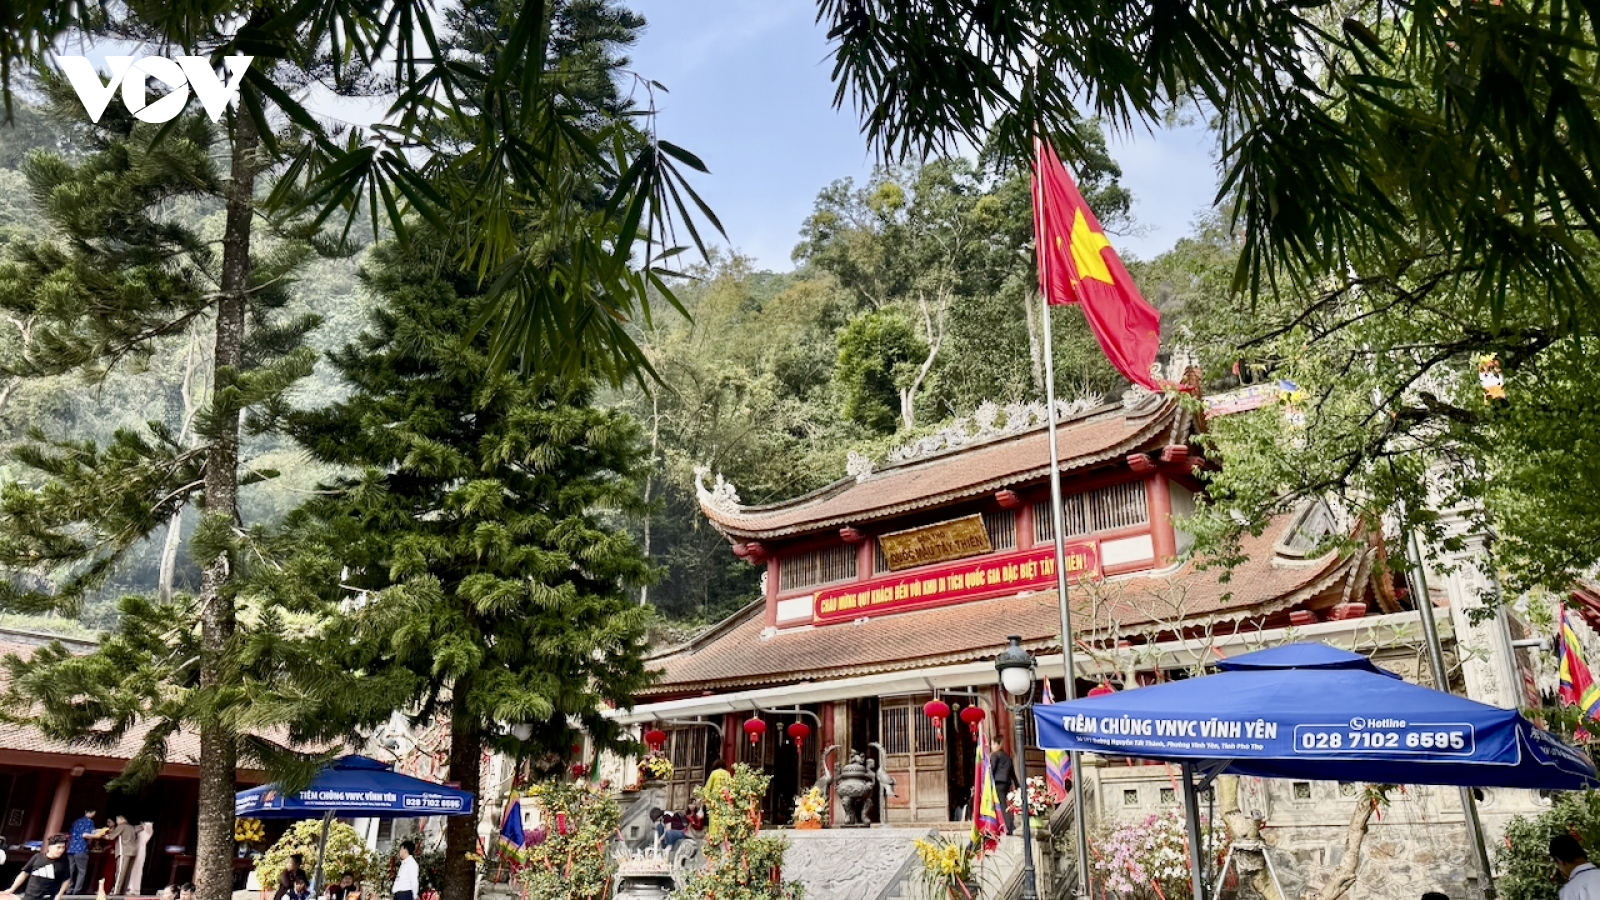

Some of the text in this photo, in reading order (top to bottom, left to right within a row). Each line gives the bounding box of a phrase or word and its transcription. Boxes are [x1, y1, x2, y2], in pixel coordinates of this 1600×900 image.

[954, 535, 984, 550] THIÊN
[821, 595, 837, 613] CHÀO
[838, 592, 857, 611] MỪNG
[858, 588, 870, 608] QUÝ
[871, 585, 894, 604] KHÁCH
[895, 580, 909, 600] ĐẾN
[910, 579, 921, 597] VỚI
[923, 578, 937, 595] KHU
[939, 577, 946, 593] DI
[947, 572, 964, 590] TÍCH
[965, 565, 985, 588] QUỐC
[987, 567, 1001, 585] GIA
[1002, 563, 1018, 583] ĐẶC
[1020, 559, 1037, 580] BIỆT
[1040, 556, 1055, 576] TÂY
[1063, 714, 1277, 739] TIÊM CHỦNG VNVC VĨNH YÊN
[1367, 719, 1406, 729] Hotline
[1302, 731, 1465, 749] 028 7102 6595
[300, 789, 397, 802] TIÊM CHỦNG VNVC VĨNH YÊN
[406, 798, 421, 806] 028
[423, 798, 440, 807] 7102
